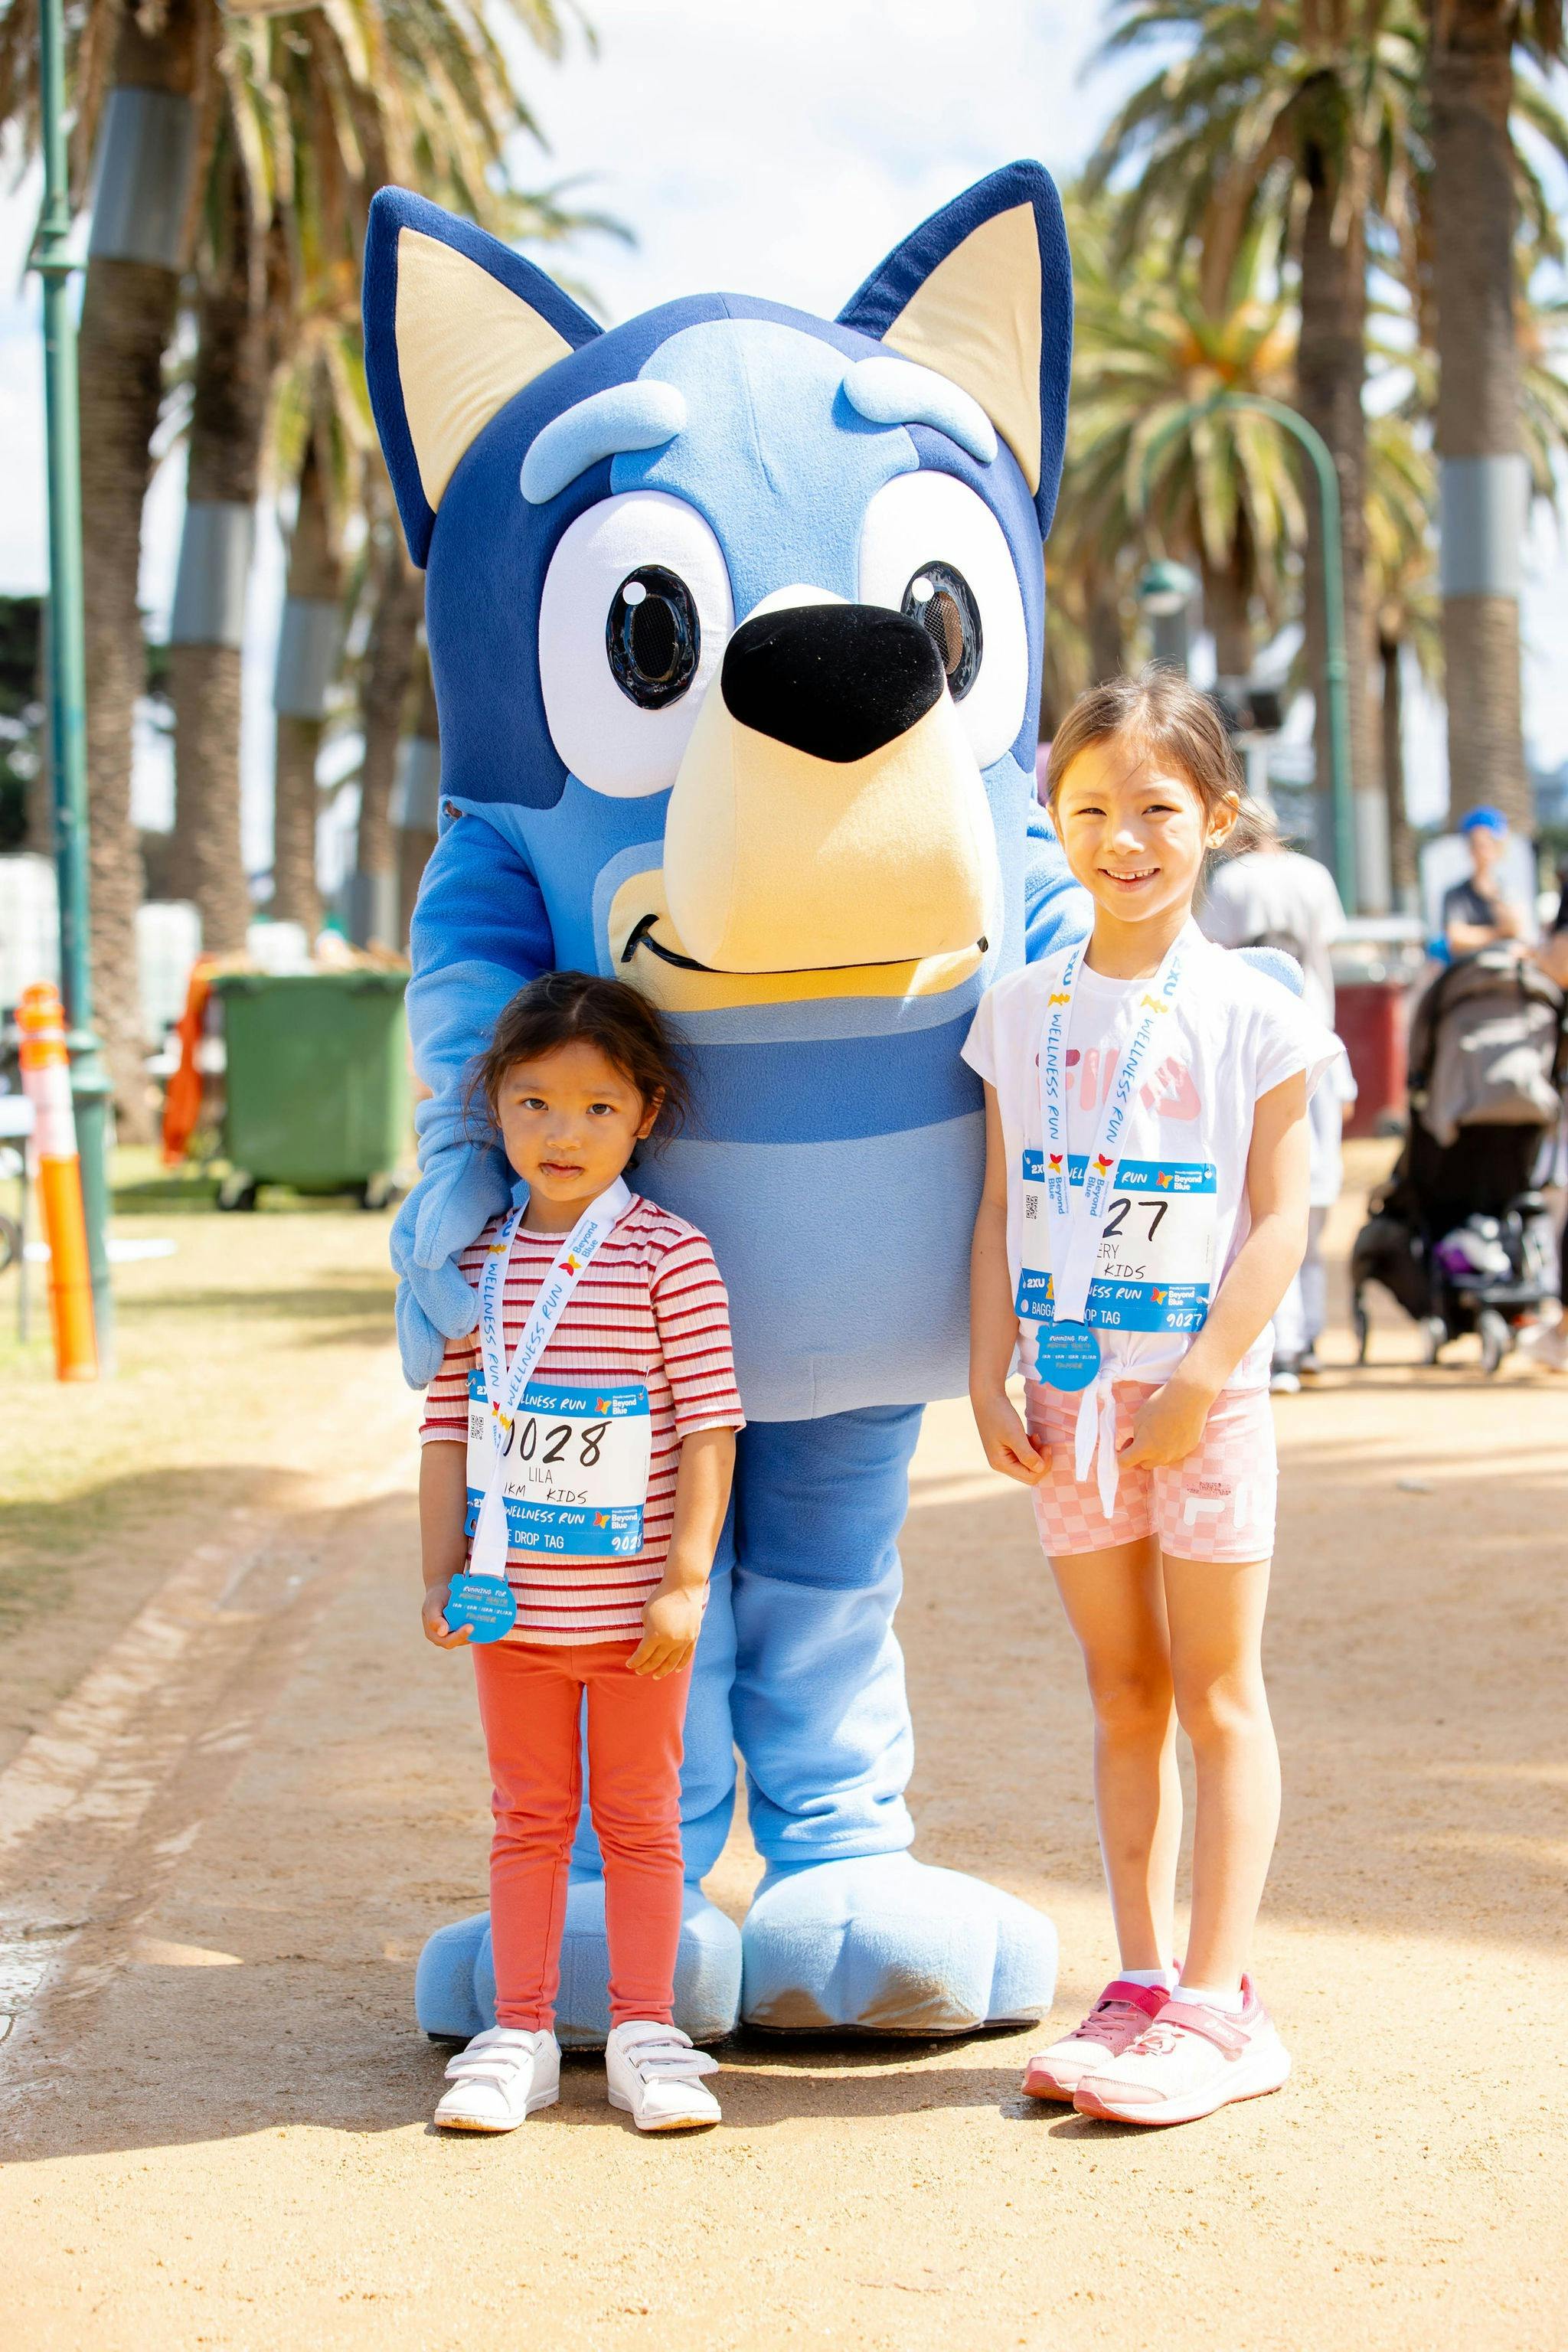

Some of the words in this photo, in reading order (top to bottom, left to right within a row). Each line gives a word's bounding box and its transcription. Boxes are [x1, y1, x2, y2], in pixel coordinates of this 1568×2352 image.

[1046, 1014, 1062, 1098] WELLNESS
[1117, 1018, 1154, 1102] WELLNESS
[1047, 1105, 1060, 1139] RUN
[1106, 1106, 1124, 1144] RUN
[1085, 1176, 1096, 1198] Blue
[1122, 1171, 1148, 1184] RUN
[1174, 1174, 1203, 1184] Beyond
[1055, 1177, 1065, 1214] Beyond
[1089, 1179, 1105, 1217] Beyond
[1102, 1198, 1168, 1241] 27
[573, 1221, 598, 1253] Beyond
[581, 1239, 598, 1258] Blue
[1105, 1263, 1146, 1279] KIDS
[1027, 1278, 1046, 1288] 2XU
[1116, 1287, 1142, 1299] RUN
[1168, 1290, 1194, 1299] Beyond
[484, 1263, 498, 1345] WELLNESS
[1032, 1302, 1055, 1317] BAGGA
[1085, 1308, 1097, 1321] OP
[1101, 1310, 1121, 1325] TAG
[1166, 1312, 1203, 1328] 9027
[508, 1321, 544, 1406] WELLNESS
[542, 1284, 563, 1320] RUN
[488, 1353, 499, 1387] RUN
[521, 1394, 557, 1410] LLNESS
[560, 1398, 586, 1410] RUN
[612, 1398, 636, 1408] Beyond
[529, 1467, 553, 1484] LILA
[505, 1482, 526, 1497] 1KM
[547, 1488, 588, 1504] KIDS
[505, 1506, 556, 1523] WELLNESS
[558, 1512, 585, 1524] RUN
[612, 1514, 637, 1524] Beyond
[514, 1530, 540, 1546] DROP
[544, 1534, 564, 1549] TAG
[612, 1533, 642, 1551] 9028
